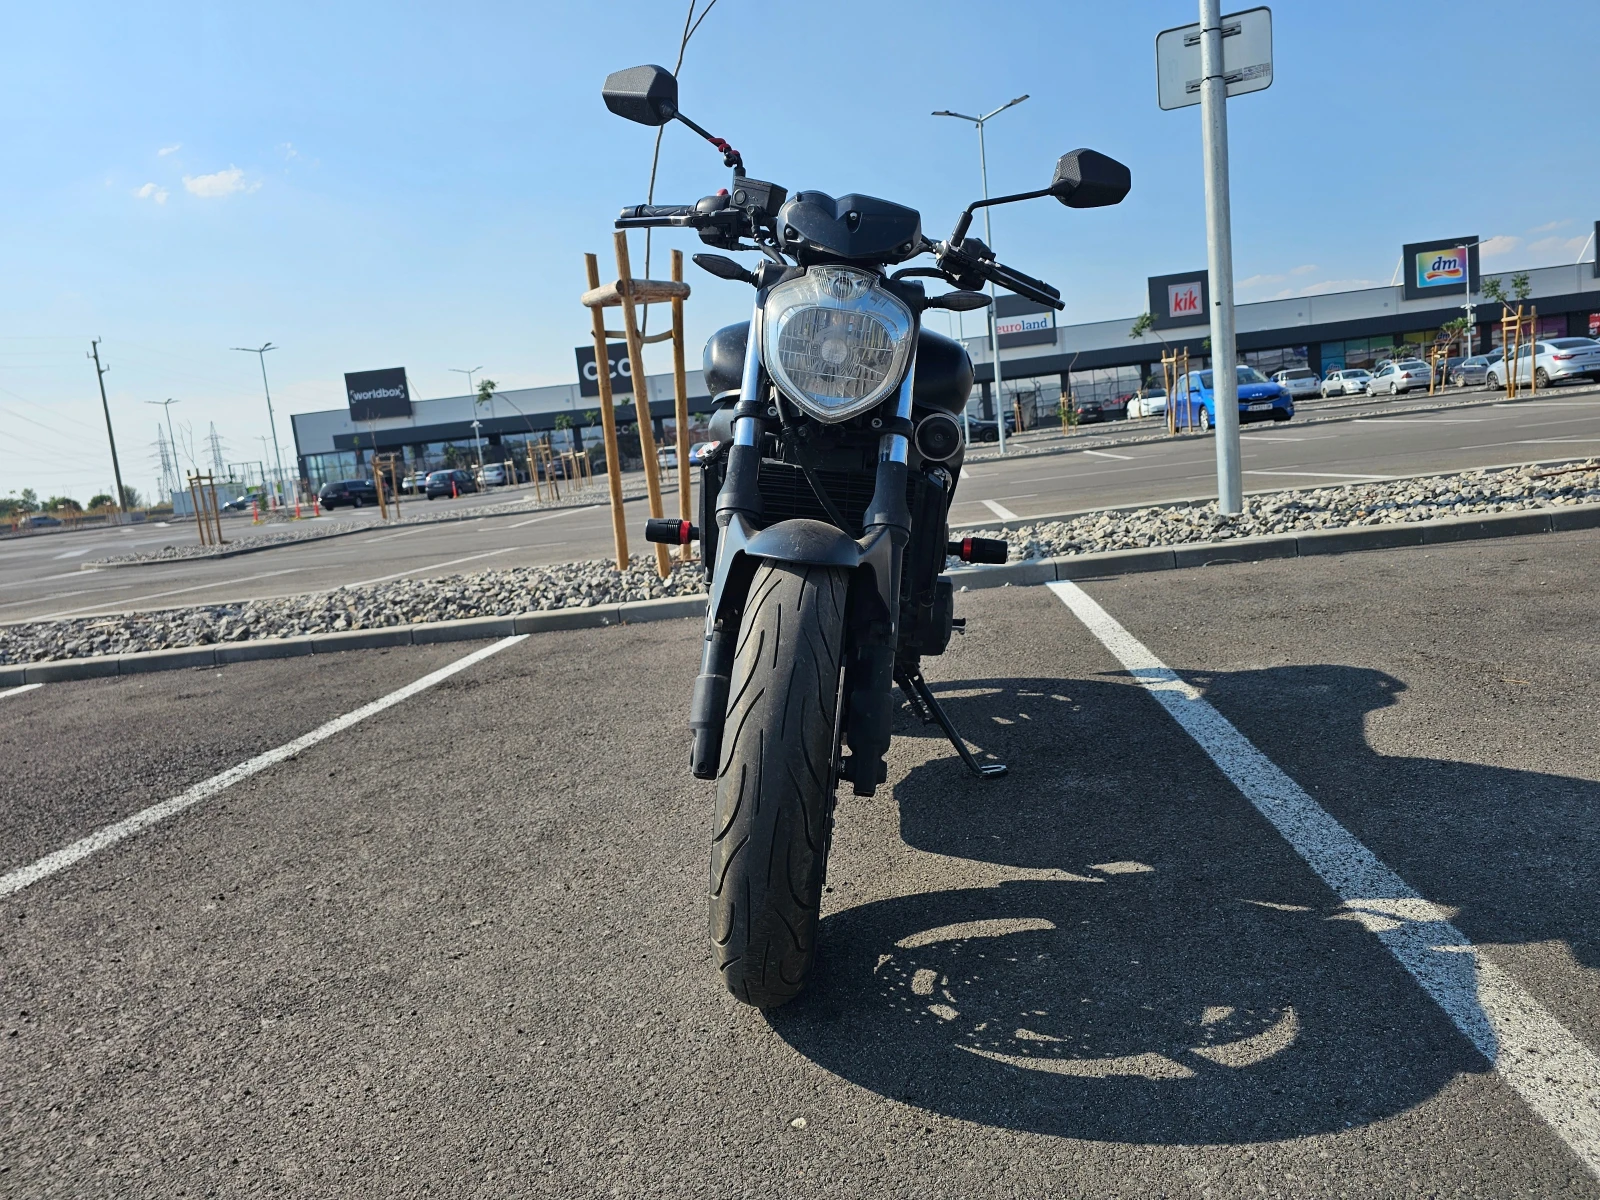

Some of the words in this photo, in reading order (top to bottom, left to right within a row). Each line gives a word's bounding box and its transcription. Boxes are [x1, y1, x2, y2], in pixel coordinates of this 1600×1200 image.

[1431, 257, 1457, 271] dm
[996, 317, 1048, 334] euroland
[353, 387, 401, 401] worldbox
